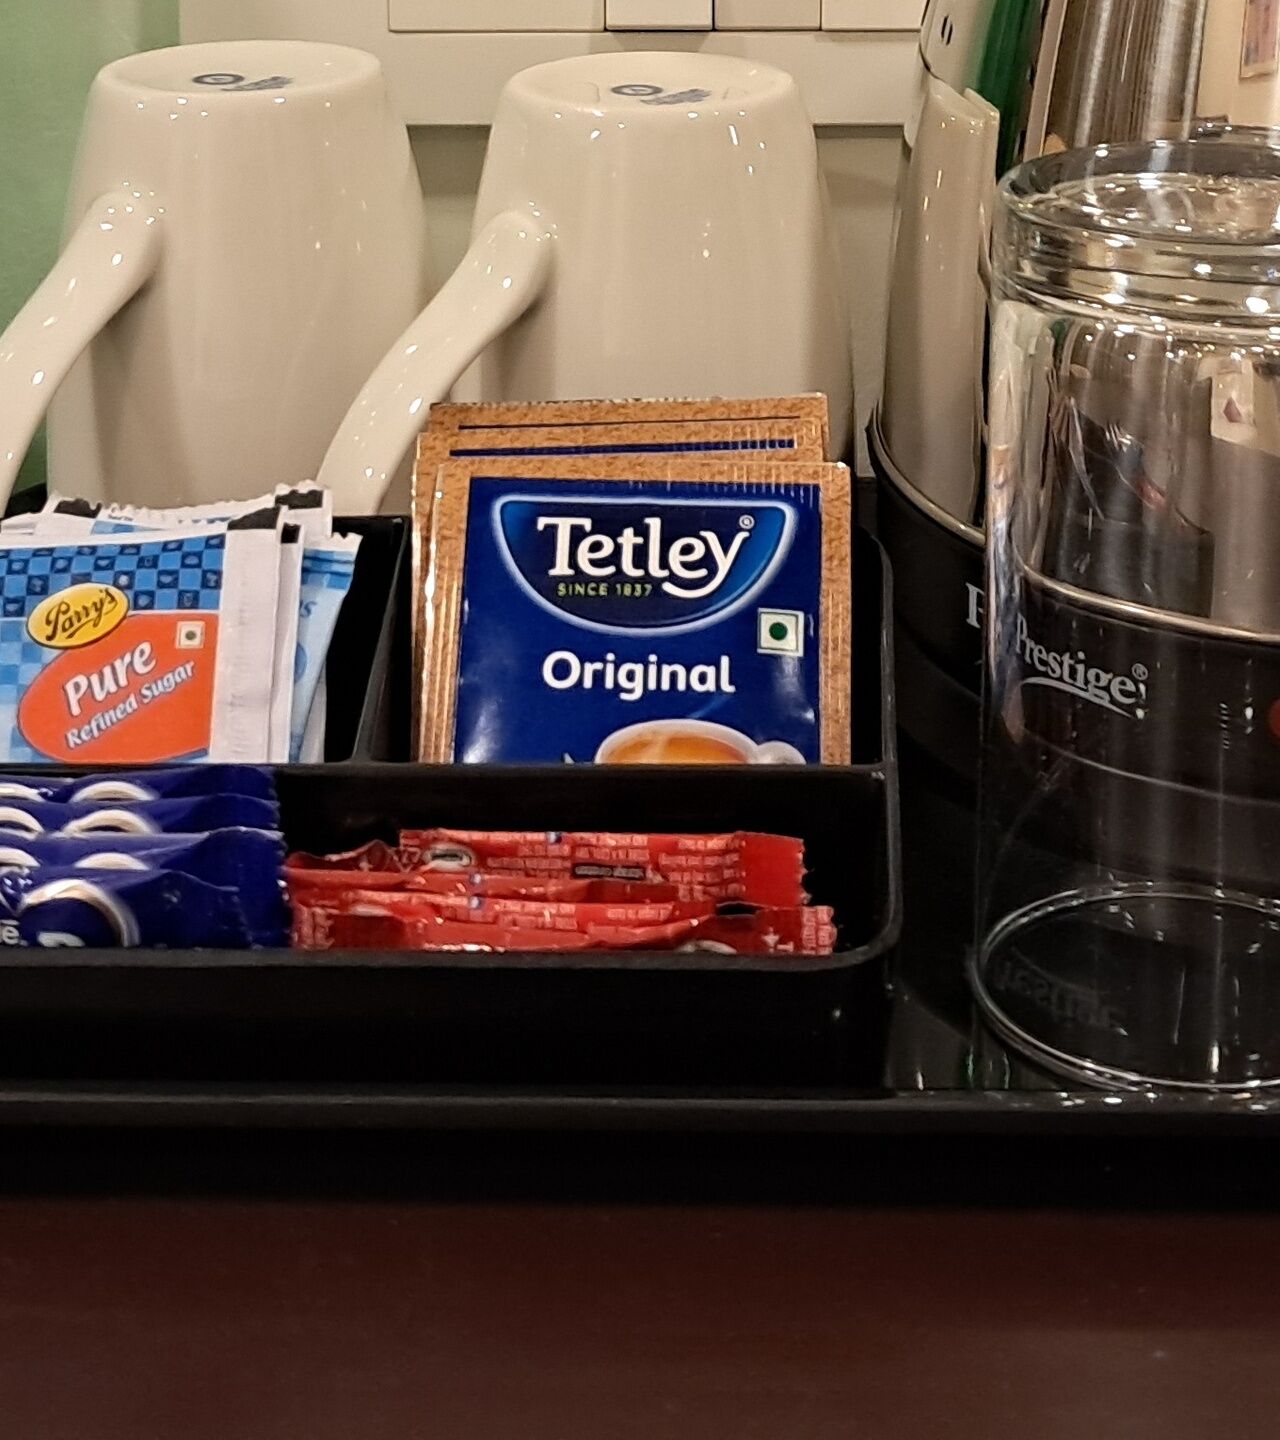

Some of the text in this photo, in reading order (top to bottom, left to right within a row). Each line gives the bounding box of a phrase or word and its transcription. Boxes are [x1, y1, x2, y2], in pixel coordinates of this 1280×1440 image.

[537, 517, 750, 599] Tetley
[557, 583, 653, 596] SINCE 1837
[45, 588, 118, 642] Parry's
[64, 641, 156, 716] Pure
[542, 651, 736, 701] Original
[1016, 612, 1138, 705] Prestige
[66, 661, 195, 749] Refined Sugar
